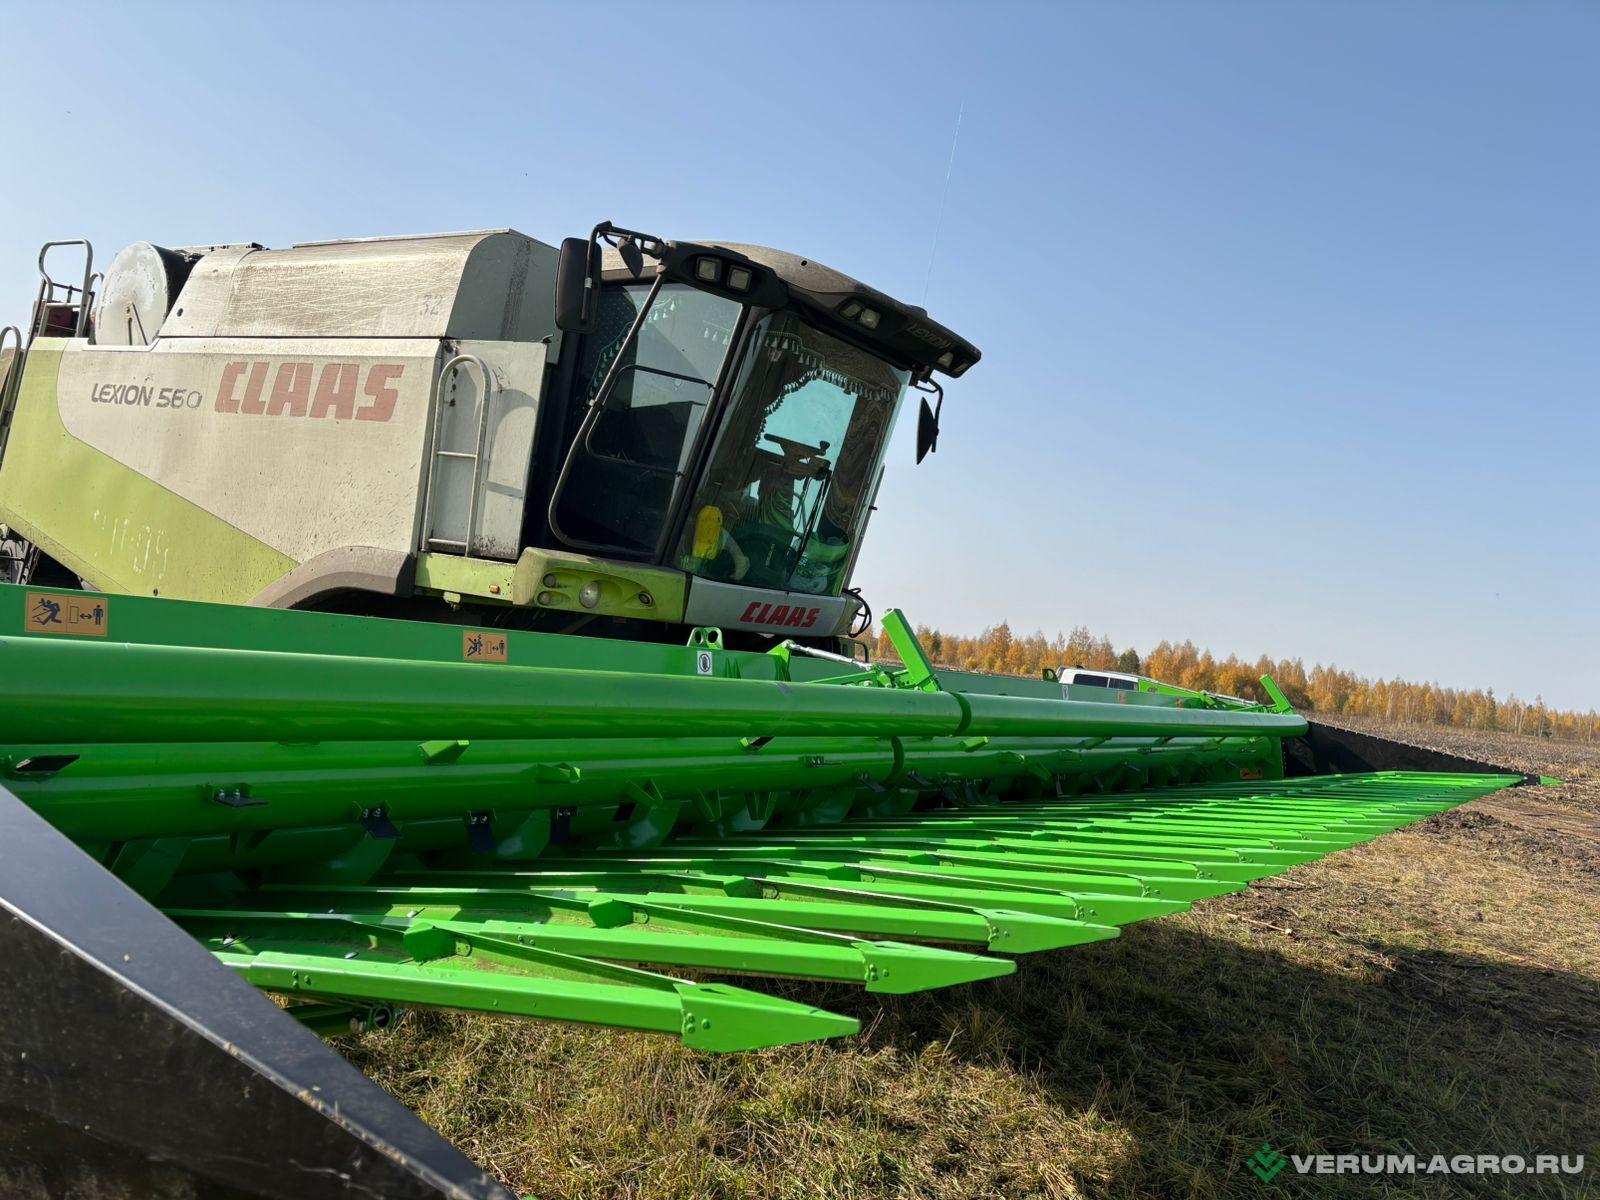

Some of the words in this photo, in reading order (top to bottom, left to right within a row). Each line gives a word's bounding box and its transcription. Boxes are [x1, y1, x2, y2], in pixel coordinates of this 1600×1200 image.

[91, 383, 154, 406] LEXION
[156, 387, 202, 409] 560
[214, 361, 405, 422] CLAAS
[740, 601, 821, 628] CLAAS
